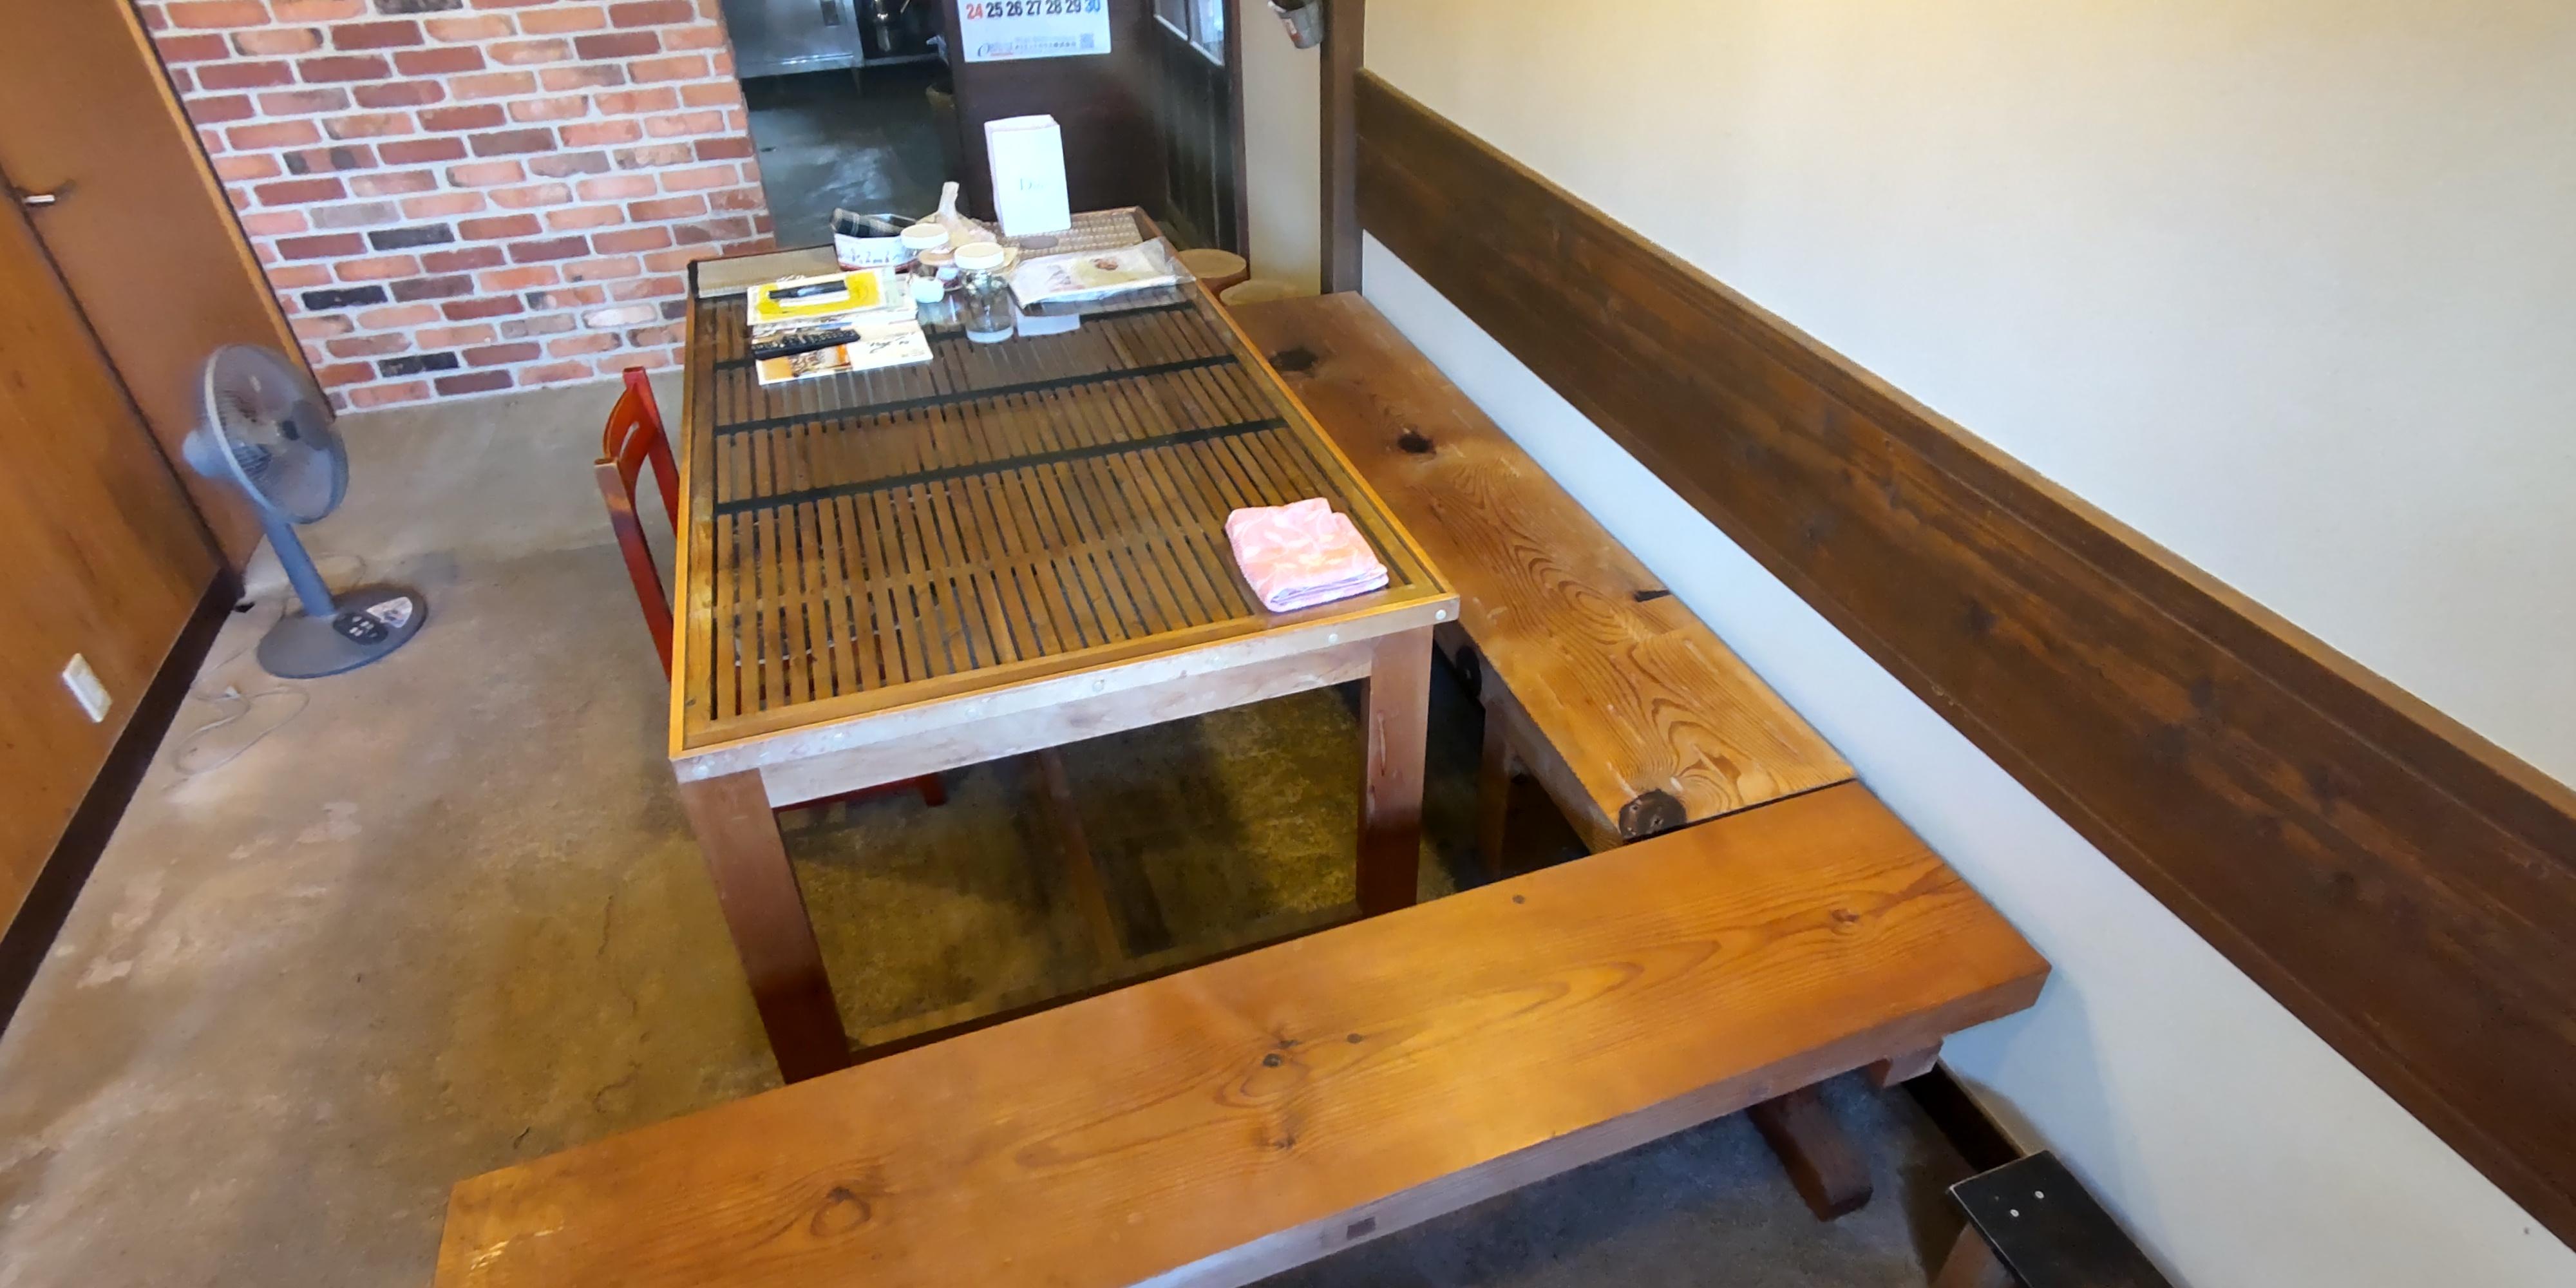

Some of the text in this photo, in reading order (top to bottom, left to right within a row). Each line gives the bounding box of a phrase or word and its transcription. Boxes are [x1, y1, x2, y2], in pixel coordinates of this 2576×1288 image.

[966, 0, 1101, 19] 24 25 26 27 28 29 30
